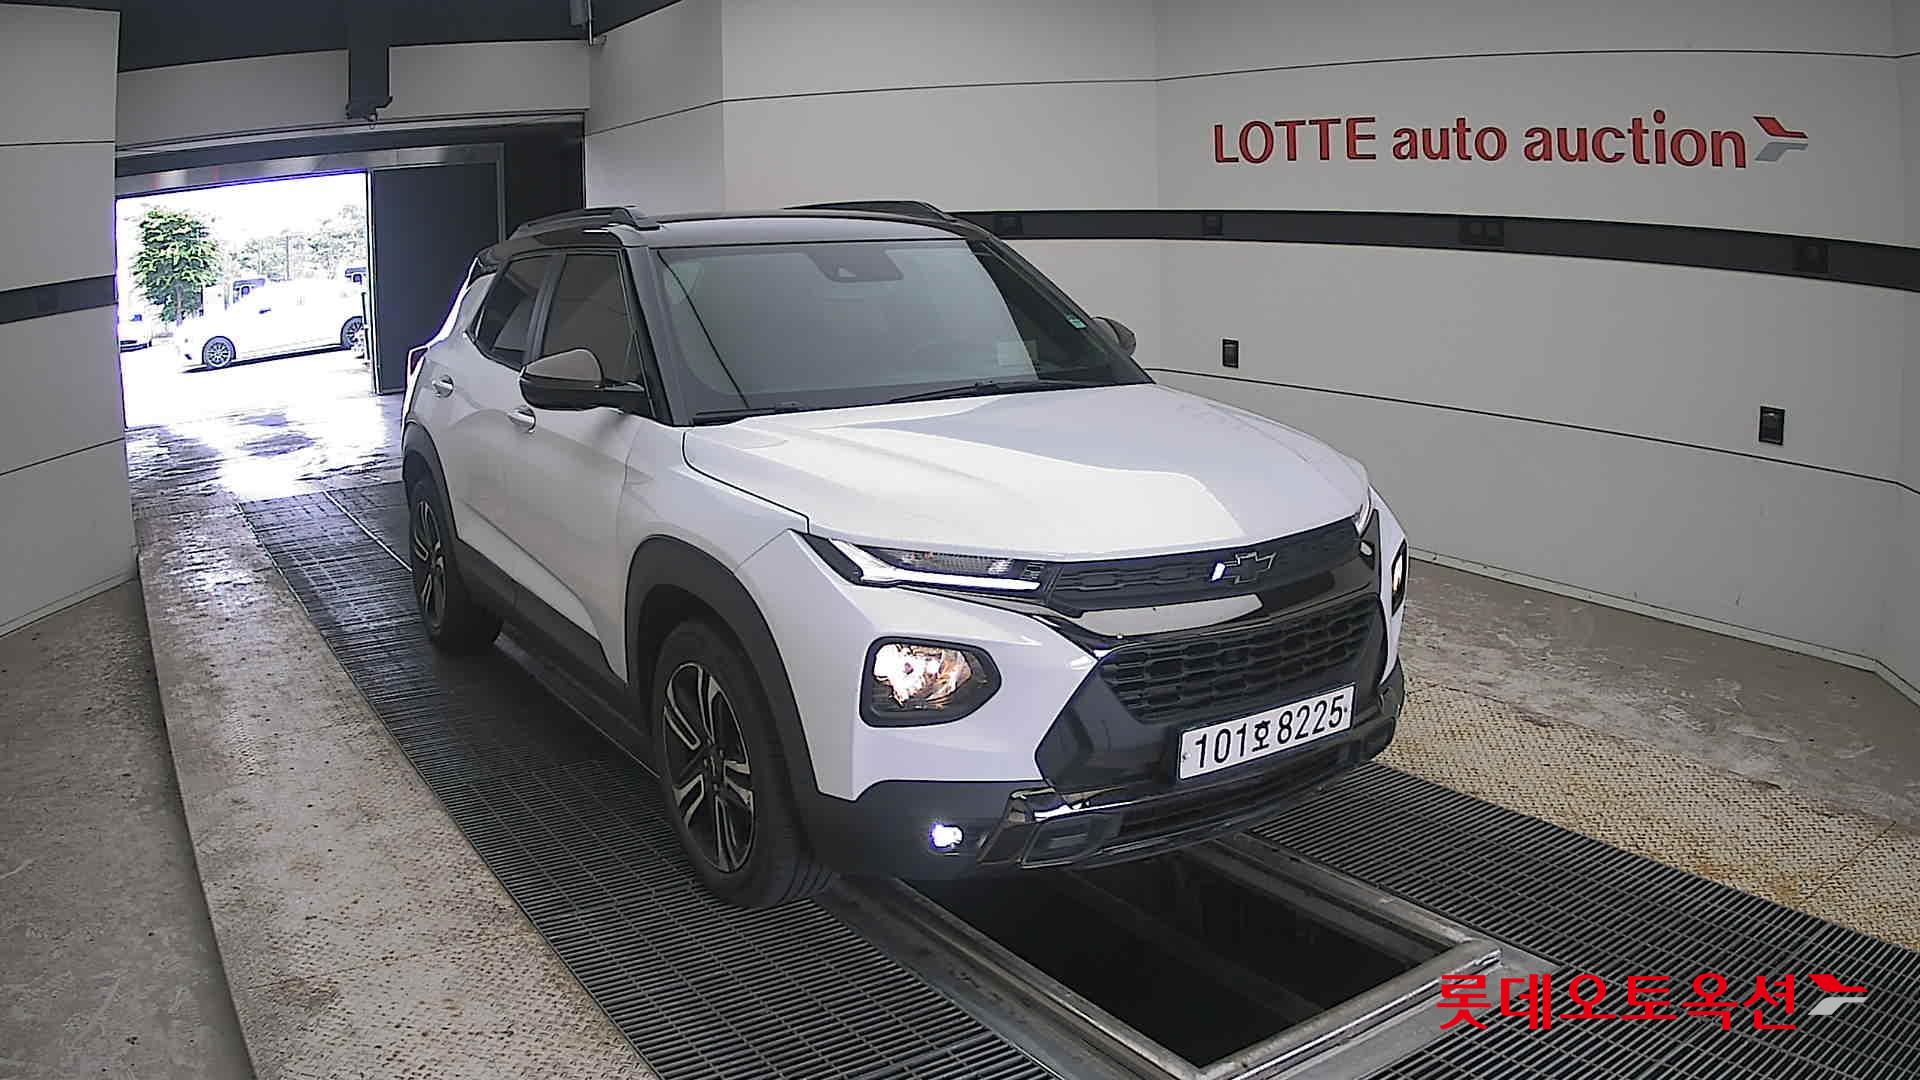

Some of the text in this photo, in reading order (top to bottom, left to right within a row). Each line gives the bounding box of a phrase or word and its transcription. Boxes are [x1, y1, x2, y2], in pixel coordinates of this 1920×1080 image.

[1214, 109, 1747, 168] LOTTE auto auction
